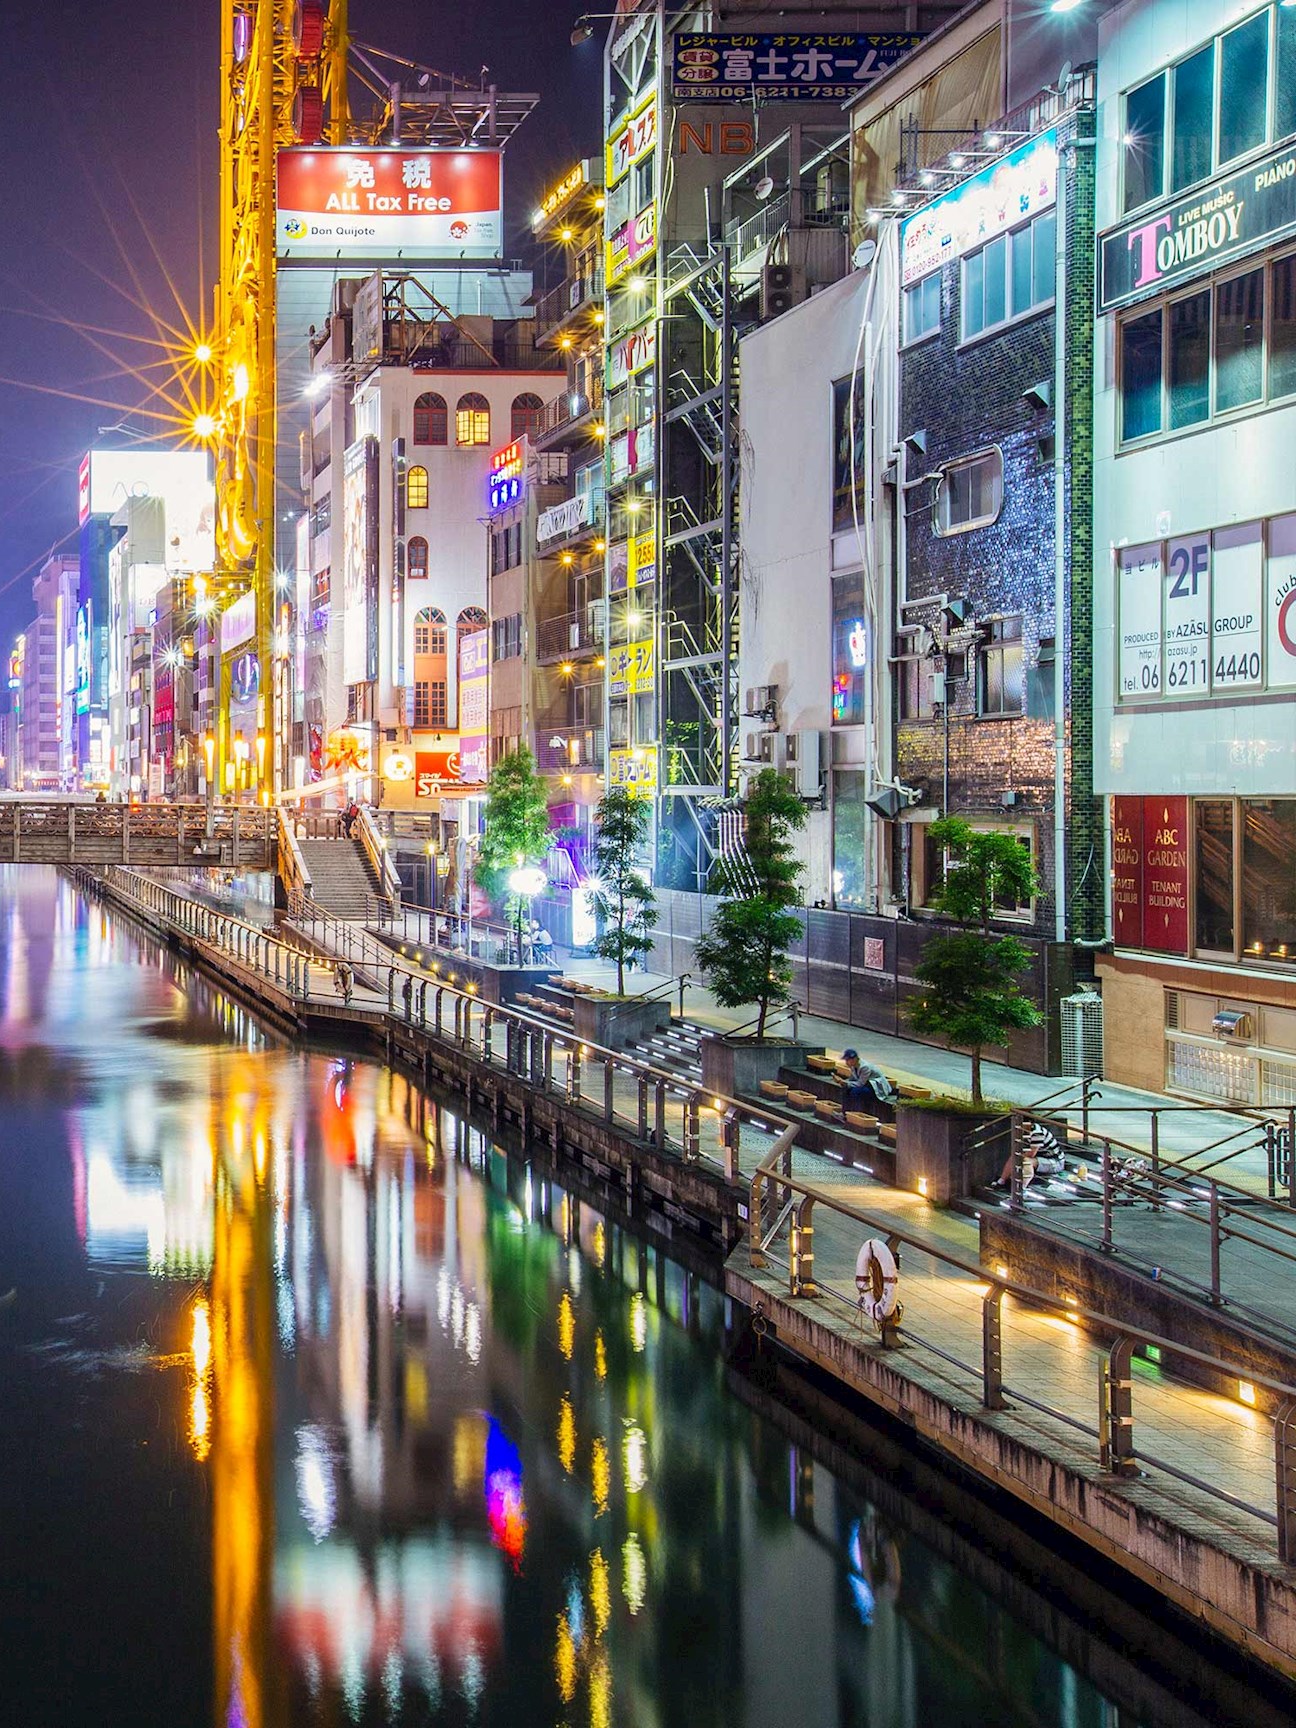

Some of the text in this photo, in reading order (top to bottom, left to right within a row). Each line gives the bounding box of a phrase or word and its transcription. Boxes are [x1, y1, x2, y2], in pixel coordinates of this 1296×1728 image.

[679, 36, 758, 47] レジャービル
[772, 36, 855, 47] オフィスビル
[682, 50, 714, 64] 賃貸
[722, 48, 889, 82] 富士ホーム
[682, 67, 714, 80] 分譲
[679, 121, 754, 155] NB
[345, 158, 433, 190] 免税
[1254, 158, 1296, 193] PIANO
[325, 193, 452, 212] ALL Tax Free
[1178, 191, 1235, 227] LIVE MUSIC
[311, 226, 376, 239] Don Quijote
[1127, 201, 1245, 288] TOMBOY
[1169, 544, 1209, 599] 2F
[1124, 631, 1159, 645] PRODUCED
[1167, 630, 1176, 639] BY
[1214, 614, 1253, 633] GROUP
[1124, 652, 1260, 691] tel. 06 6211 4440
[1155, 828, 1179, 846] ABC
[1147, 850, 1186, 867] GARDEN
[1152, 881, 1182, 894] TENANT
[1149, 894, 1185, 909] BUILDING
